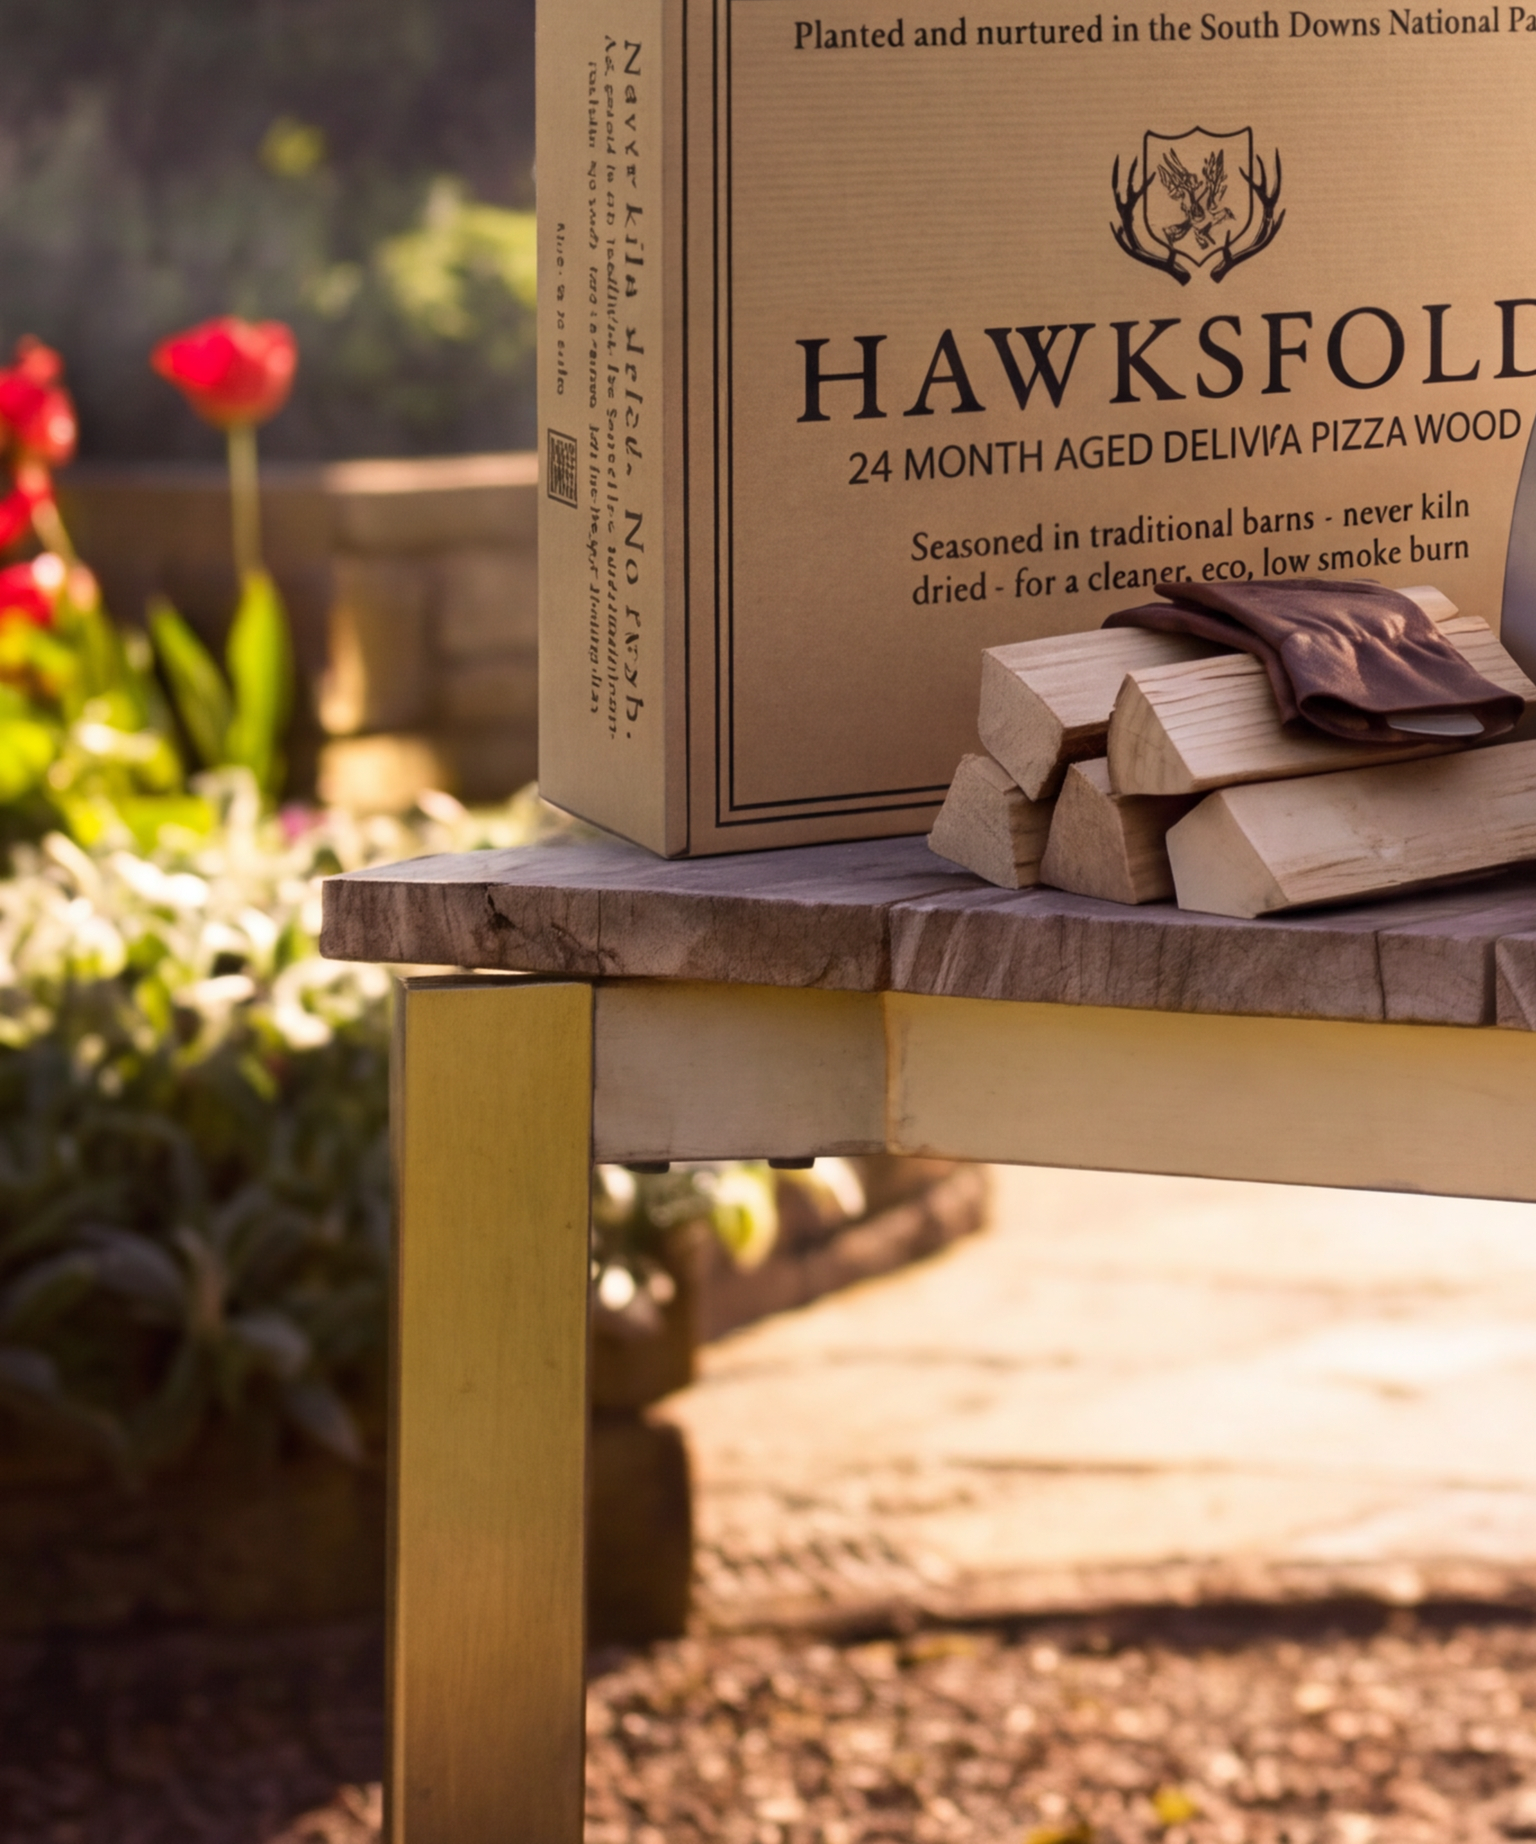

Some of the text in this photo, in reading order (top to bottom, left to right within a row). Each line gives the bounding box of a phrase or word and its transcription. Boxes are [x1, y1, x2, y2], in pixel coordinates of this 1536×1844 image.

[794, 18, 904, 50] Planted
[914, 16, 967, 47] and
[976, 14, 1102, 46] nurtured
[1112, 14, 1139, 43] in
[1148, 13, 1192, 42] the
[1200, 10, 1280, 41] South
[1288, 11, 1381, 38] Downs
[1388, 6, 1500, 36] National
[848, 449, 893, 485] 24
[904, 439, 1043, 481] MONTH
[1054, 432, 1153, 471] AGED
[1312, 416, 1407, 453] PIZZA
[1414, 408, 1521, 444] WOOD
[911, 522, 1043, 561] Seasoned
[1053, 522, 1079, 552] in
[1090, 507, 1233, 548] traditional
[1243, 506, 1315, 536] barns
[1343, 502, 1413, 528] never
[1421, 490, 1470, 520] kiln
[912, 571, 987, 605] dried
[1014, 566, 1056, 598] for
[1064, 573, 1080, 594] a
[1088, 560, 1193, 591] cleaner,
[1201, 558, 1254, 582] eco,
[1263, 547, 1310, 577] low
[1317, 537, 1401, 572] smoke
[1409, 534, 1470, 563] burn
